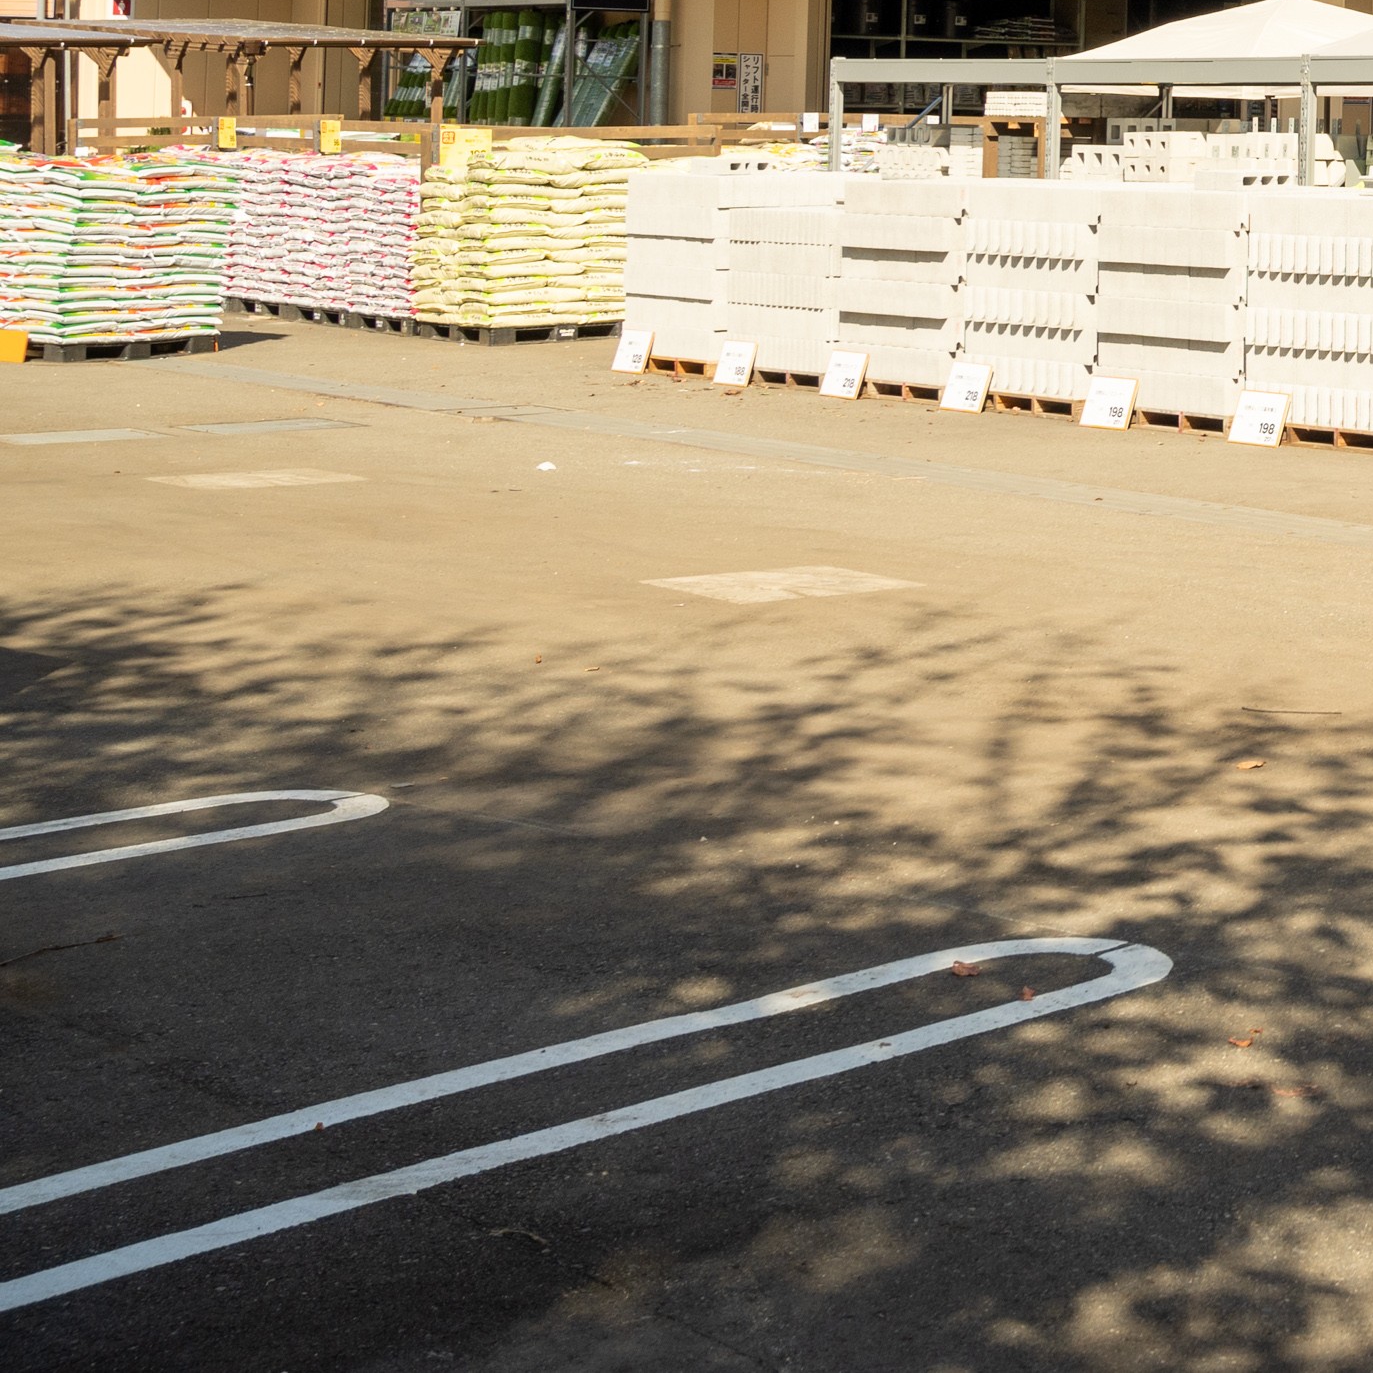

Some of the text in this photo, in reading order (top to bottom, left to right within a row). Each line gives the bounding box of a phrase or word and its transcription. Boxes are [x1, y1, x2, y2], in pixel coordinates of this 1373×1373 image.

[842, 378, 855, 389] 218
[965, 390, 978, 402] 218
[1109, 406, 1124, 418] 198
[1259, 422, 1276, 435] 198
